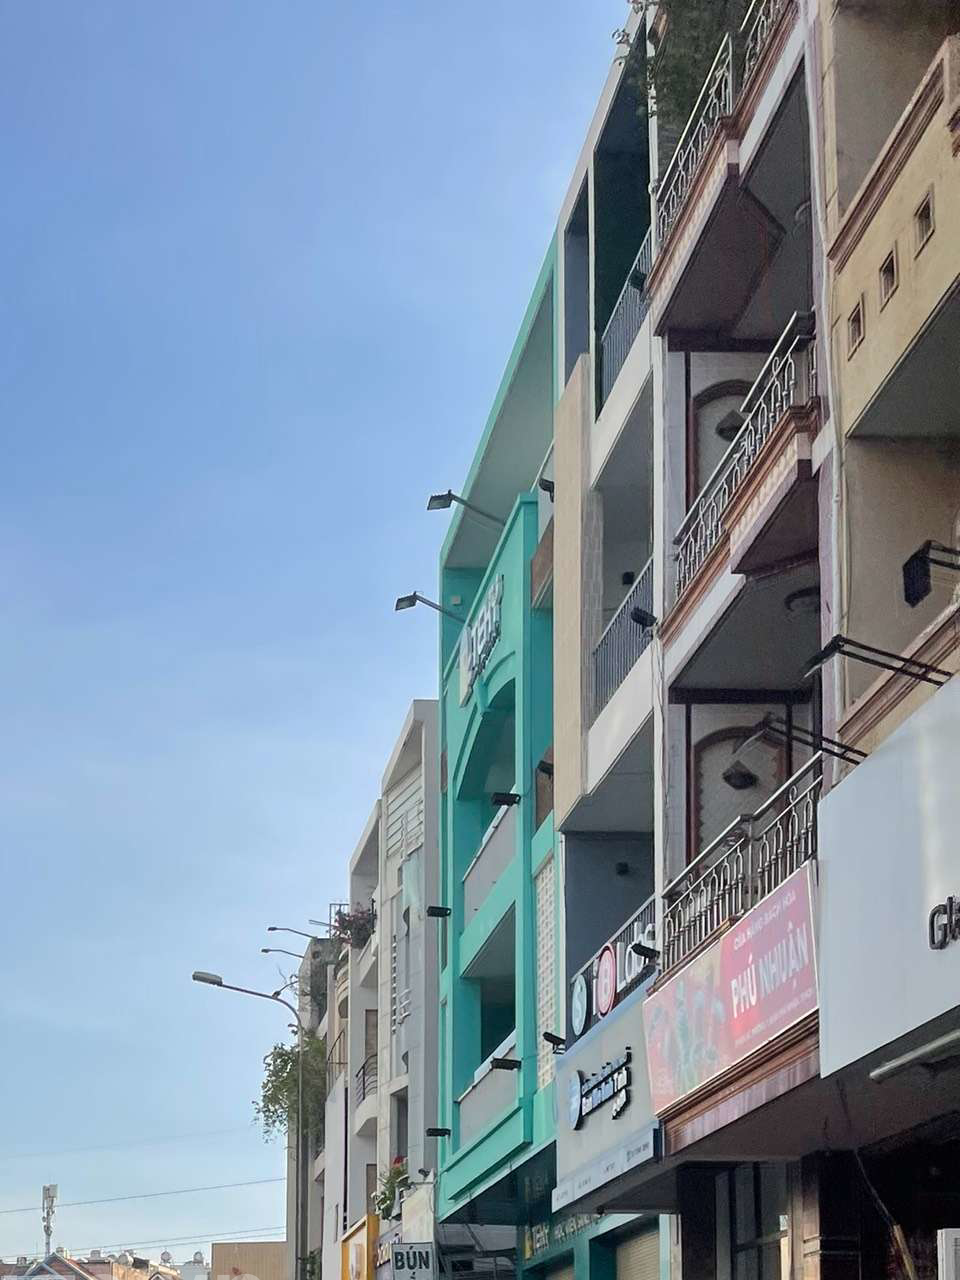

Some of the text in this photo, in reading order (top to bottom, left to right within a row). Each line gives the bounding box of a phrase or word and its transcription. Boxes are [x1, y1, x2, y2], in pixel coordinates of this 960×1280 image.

[730, 953, 758, 1019] PHÚ
[758, 920, 809, 1000] NHUẬN
[393, 1245, 431, 1272] BÚN
